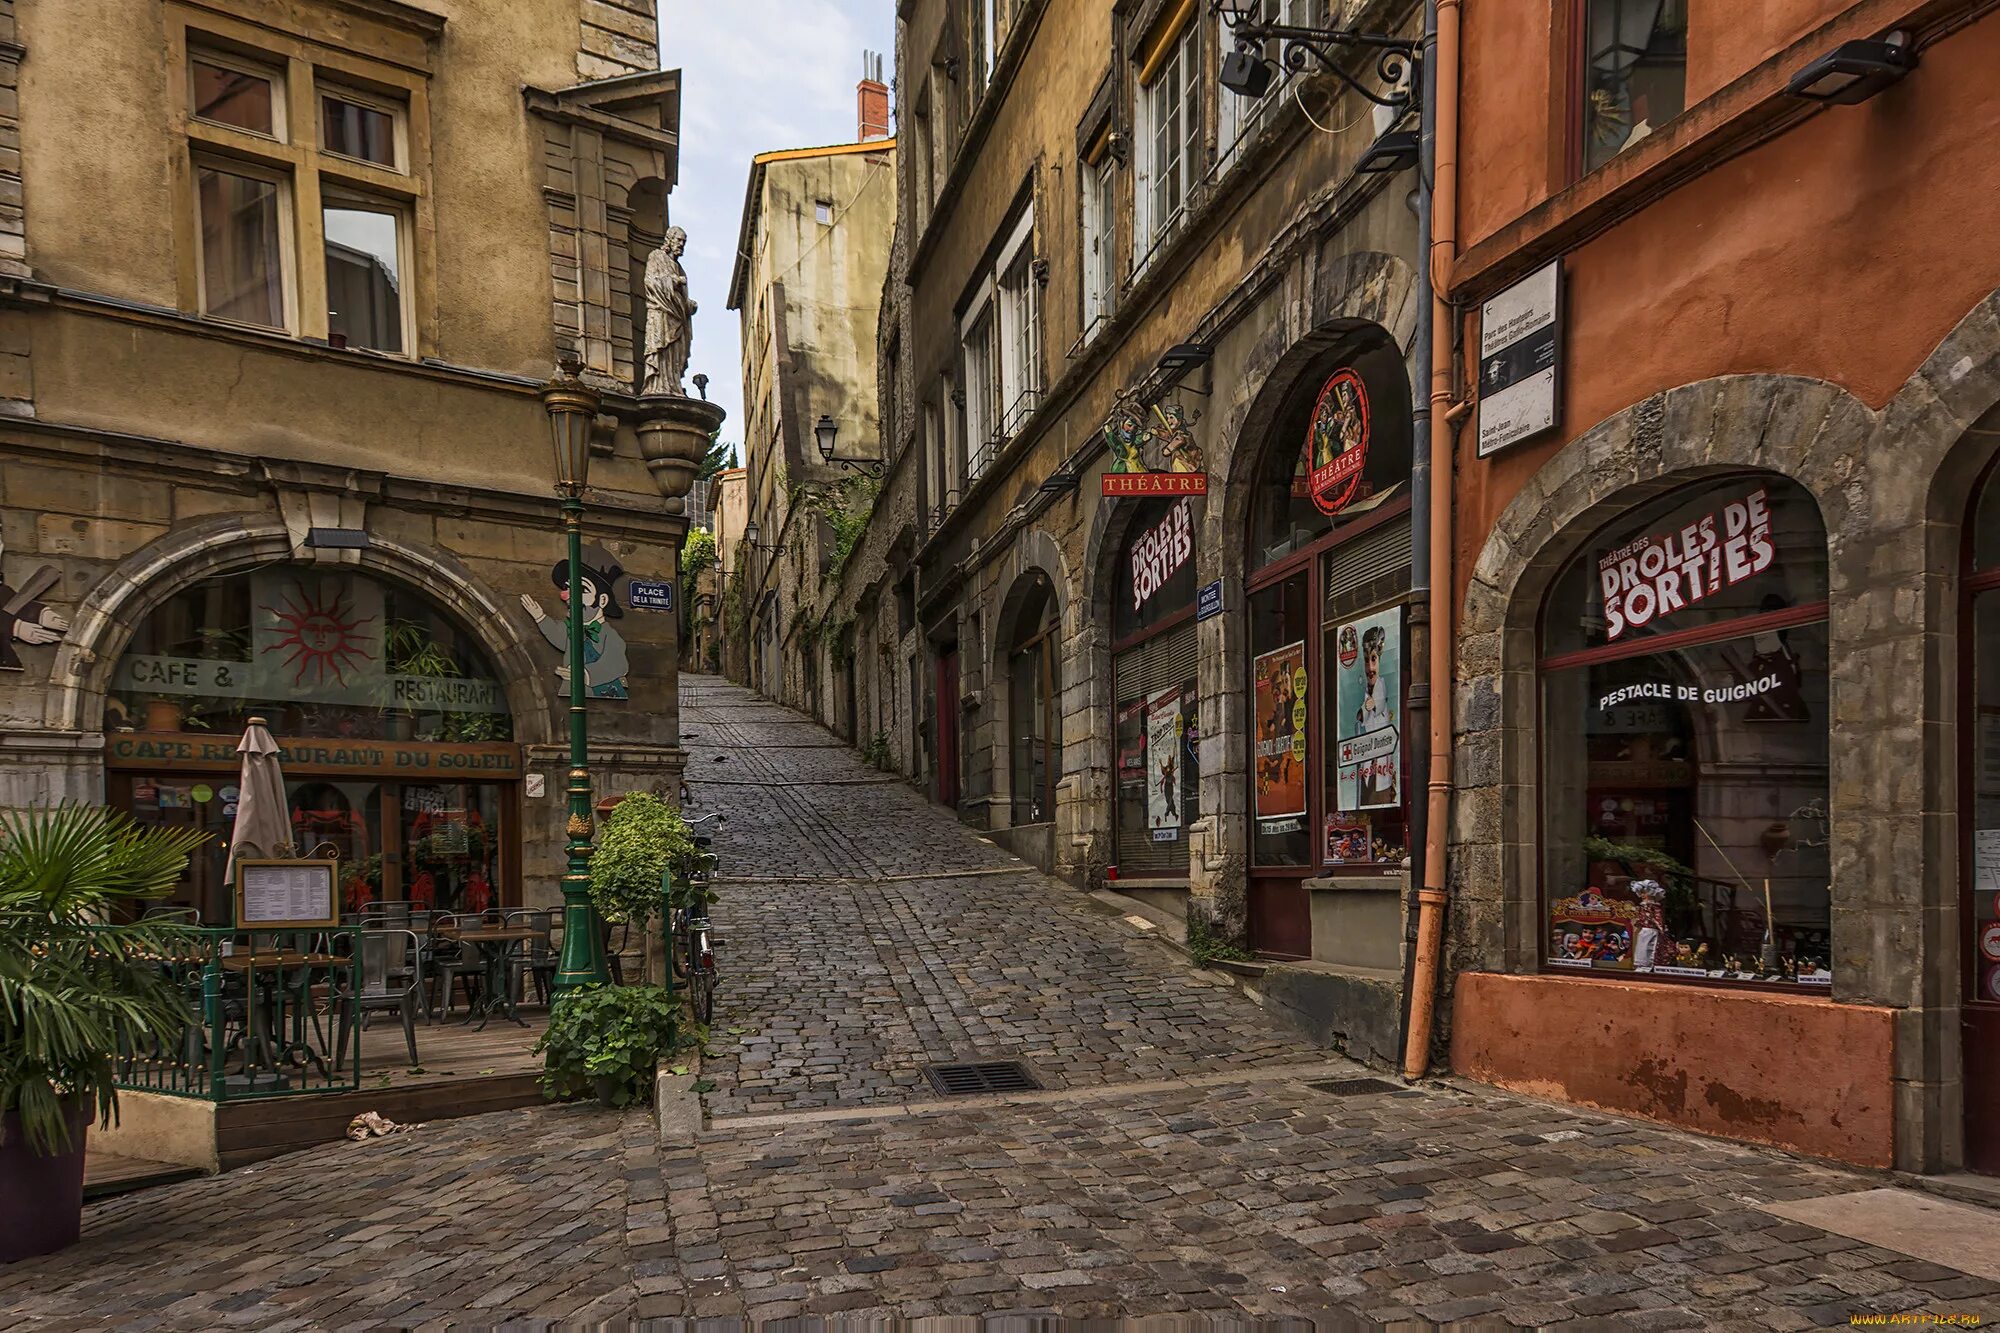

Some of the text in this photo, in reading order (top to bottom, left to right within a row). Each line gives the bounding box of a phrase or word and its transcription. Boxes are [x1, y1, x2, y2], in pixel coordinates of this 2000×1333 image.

[1484, 308, 1534, 341] Parc des Hauteurs
[1481, 420, 1511, 438] Saint-Jean
[1481, 423, 1531, 449] Métro-Funiculaire
[1314, 448, 1361, 484] THÉÂTRE
[1104, 475, 1206, 491] THÉÂTRE
[1174, 496, 1190, 531] DE
[1724, 489, 1769, 539] DE
[1598, 537, 1649, 570] THÉÂTRE DES
[633, 595, 640, 603] DE
[641, 596, 648, 604] LA
[638, 587, 664, 597] PLACE
[214, 665, 235, 689] &
[393, 678, 499, 706] RESTAURANT
[1599, 673, 1783, 711] PESTACLE DE GUIGNOL
[201, 742, 384, 767] REAURANT
[394, 751, 431, 768] DU
[437, 753, 514, 770] SOLEIL
[1353, 735, 1393, 756] Guignol Dentiste
